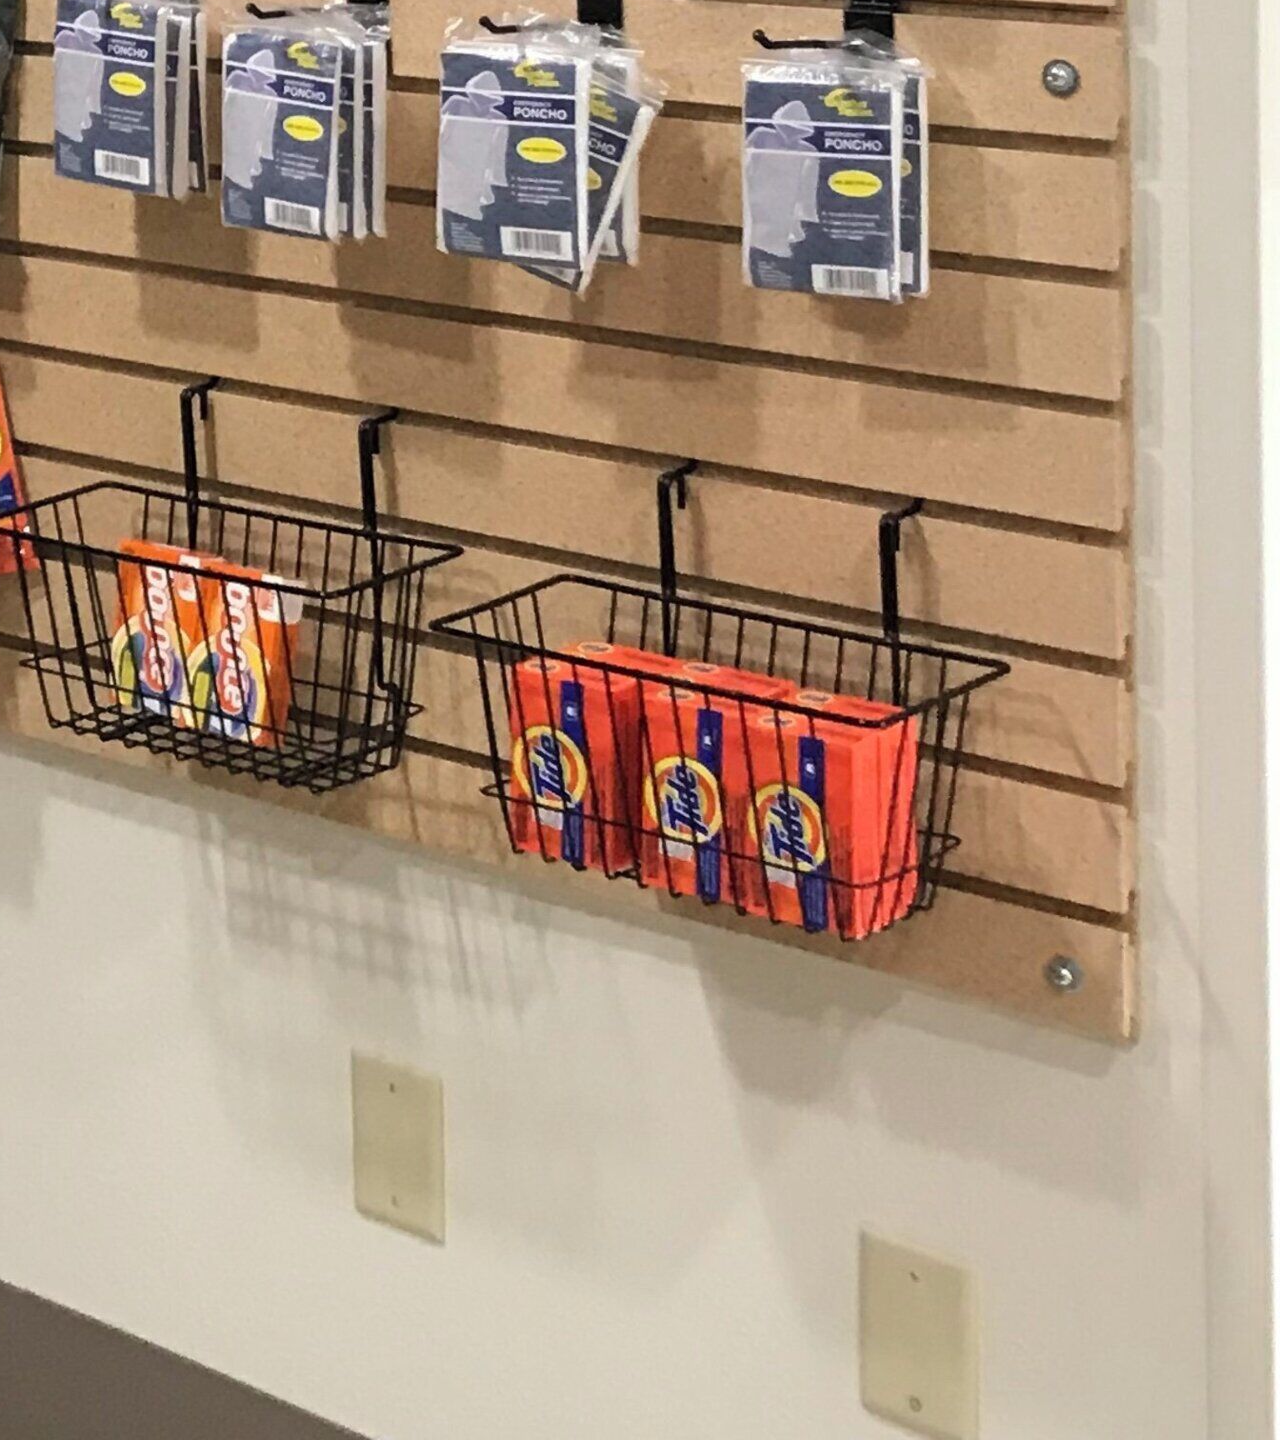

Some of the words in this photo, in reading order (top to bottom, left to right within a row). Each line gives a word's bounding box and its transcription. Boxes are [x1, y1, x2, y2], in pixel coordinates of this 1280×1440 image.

[107, 44, 149, 60] PONCHO
[282, 86, 327, 103] PONCHO
[512, 106, 568, 121] PONCHO
[824, 137, 883, 153] PONCHO
[530, 734, 573, 804] Tide
[665, 764, 710, 839] Tide
[770, 792, 817, 871] Tide
